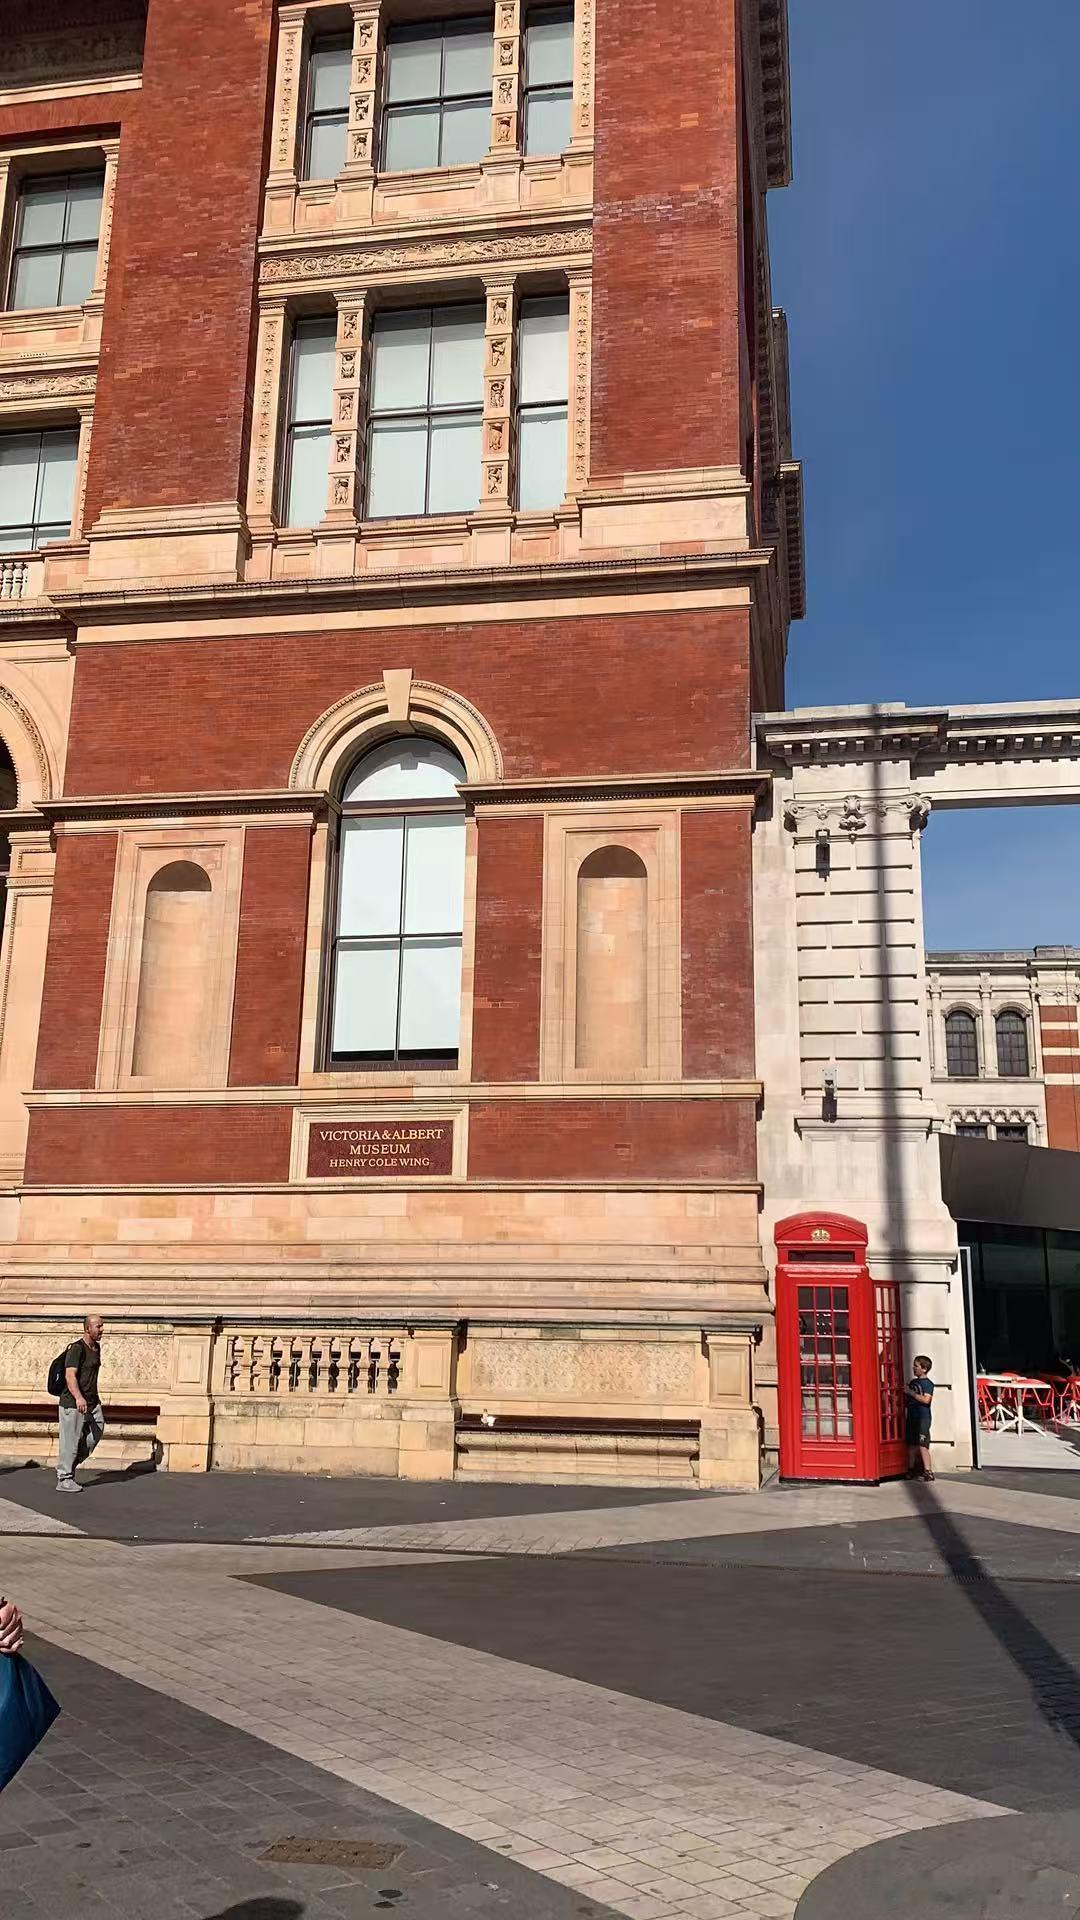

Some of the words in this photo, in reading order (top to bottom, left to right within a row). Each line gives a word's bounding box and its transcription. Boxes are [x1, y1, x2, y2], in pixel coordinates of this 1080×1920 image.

[320, 1130, 380, 1141] VICTORIA
[392, 1129, 444, 1140] ALBERT
[349, 1144, 410, 1155] MUSEUM
[329, 1158, 366, 1168] HENRY
[368, 1158, 397, 1167] COLE
[398, 1157, 430, 1167] WING
